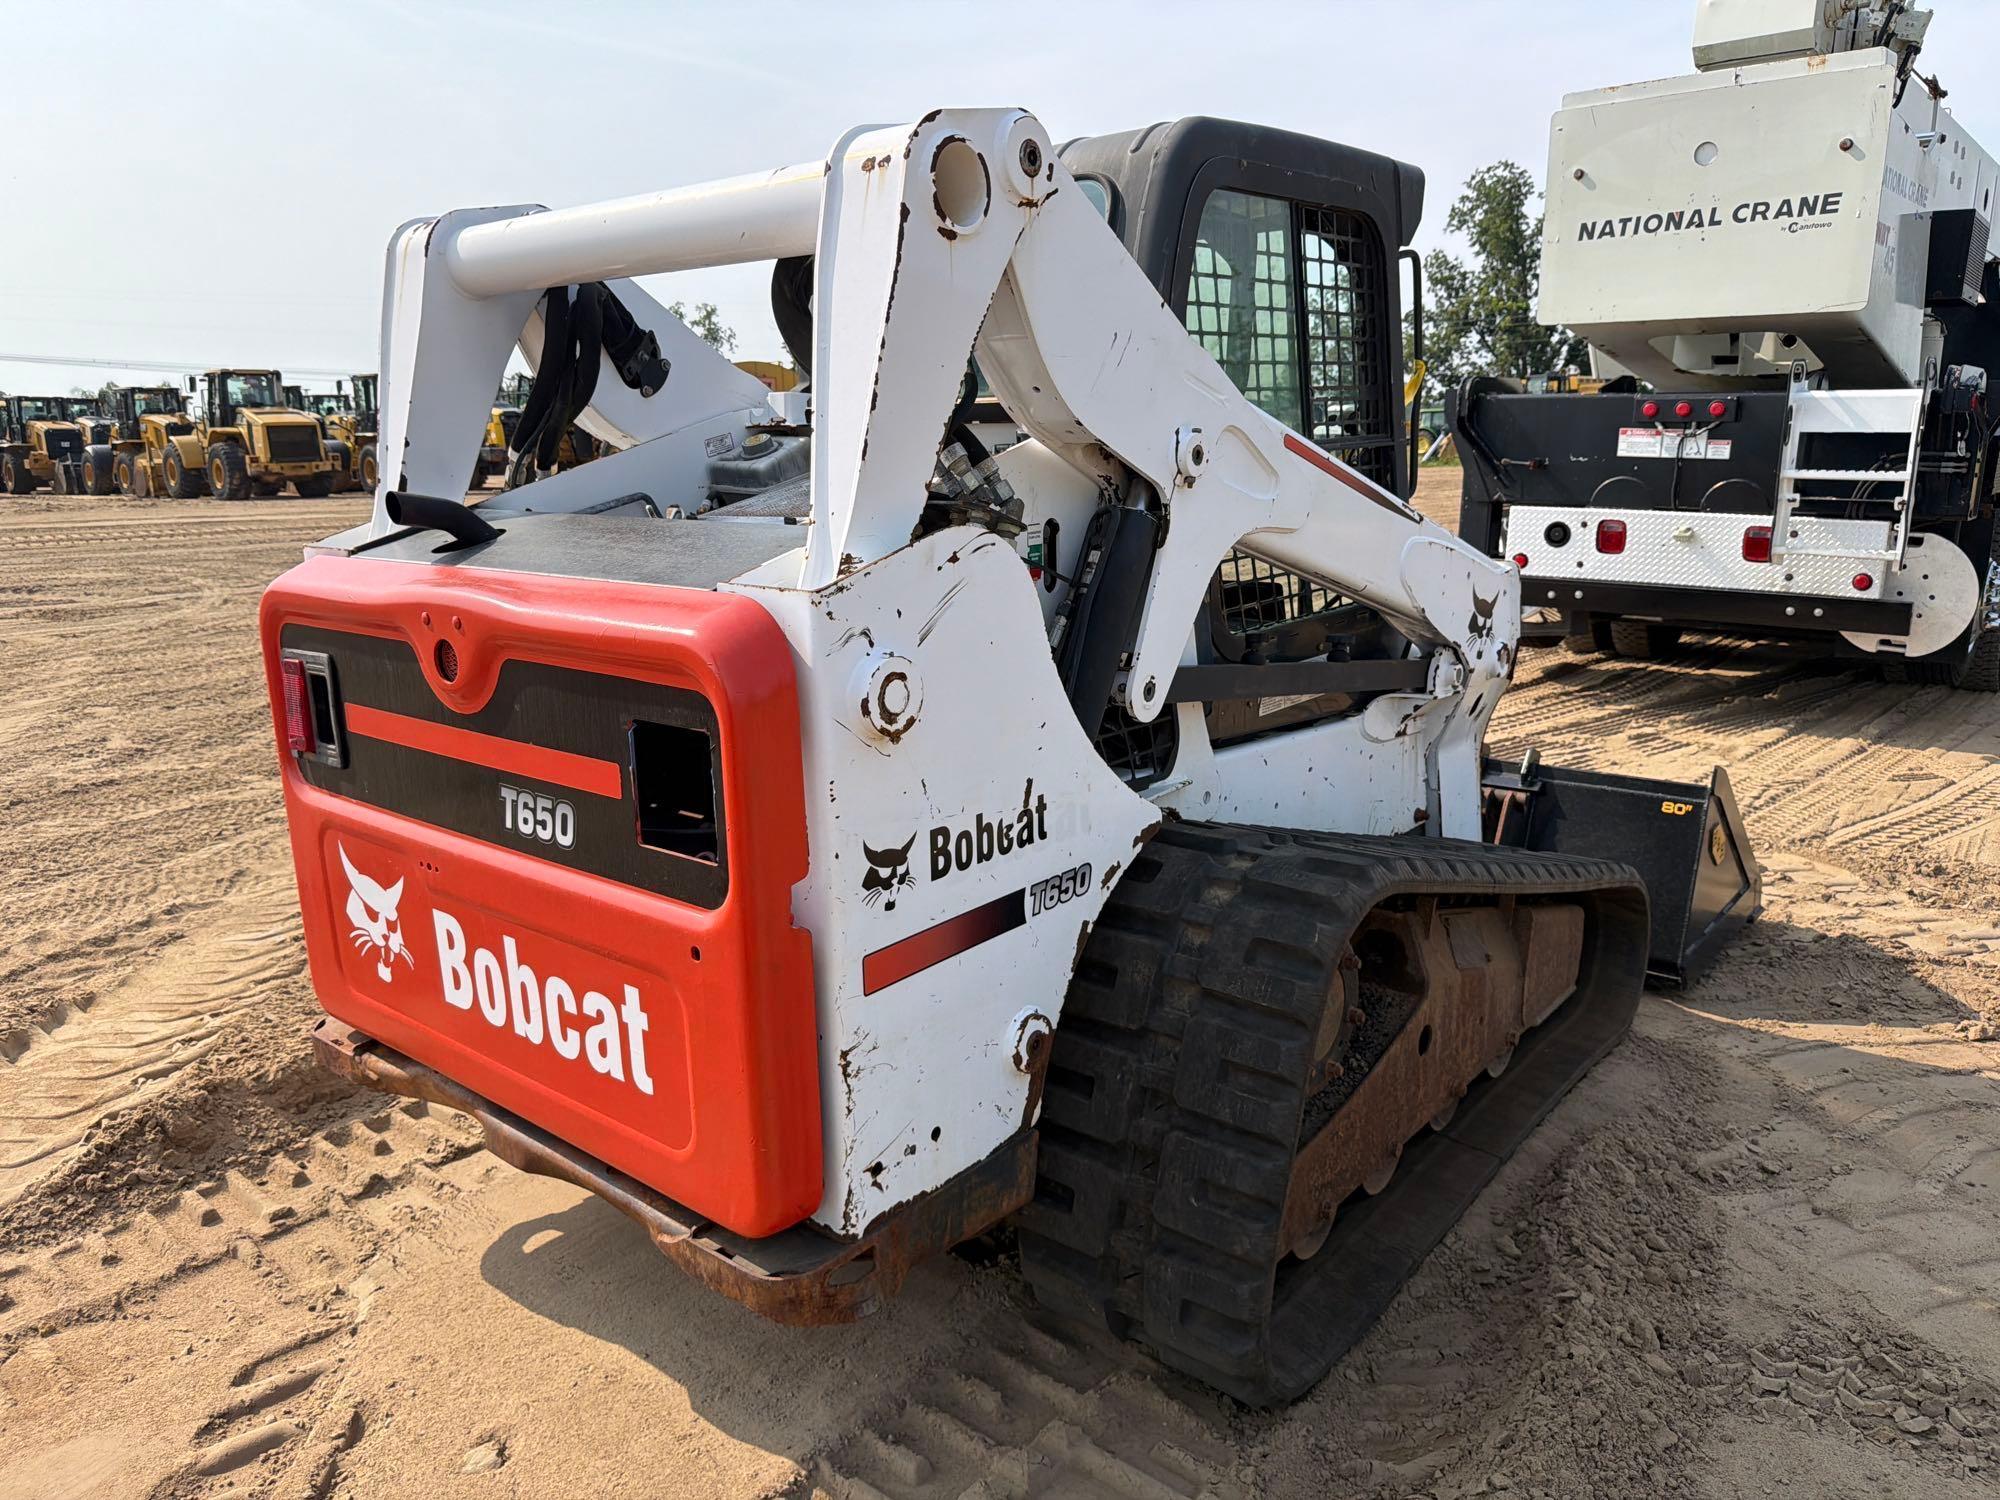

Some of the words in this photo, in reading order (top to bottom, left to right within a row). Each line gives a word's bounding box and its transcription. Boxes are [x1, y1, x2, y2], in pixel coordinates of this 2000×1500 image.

[1577, 207, 1722, 241] NATIONAL
[1732, 192, 1843, 223] CRANE
[499, 783, 576, 850] T650
[930, 795, 1047, 881] Bobcat
[1031, 863, 1092, 917] T650
[431, 907, 655, 1096] Bobcat
